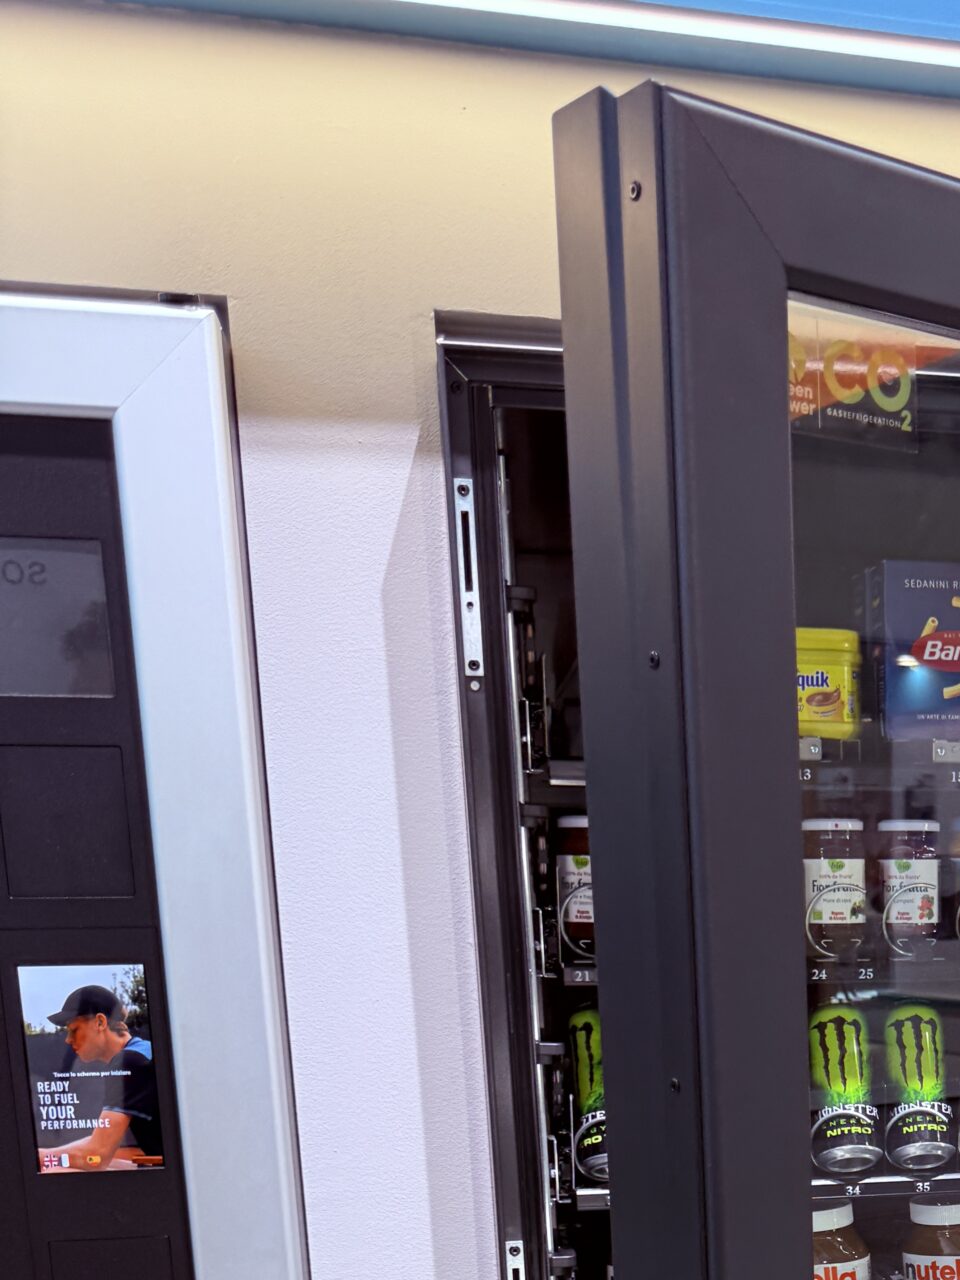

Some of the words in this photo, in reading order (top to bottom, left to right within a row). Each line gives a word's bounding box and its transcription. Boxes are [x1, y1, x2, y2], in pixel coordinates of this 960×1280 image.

[904, 578, 950, 590] SEDANINI
[797, 670, 830, 692] quik
[575, 970, 591, 982] 21
[811, 969, 828, 980] 24
[859, 968, 874, 980] 25
[37, 1080, 70, 1093] READY
[38, 1094, 51, 1105] TO
[55, 1093, 80, 1104] FUEL
[40, 1106, 75, 1120] YOUR
[40, 1118, 110, 1131] PERFORMANCE
[902, 1123, 948, 1134] NITRO
[826, 1126, 872, 1138] NITRO
[846, 1185, 862, 1196] 34
[916, 1181, 931, 1193] 35
